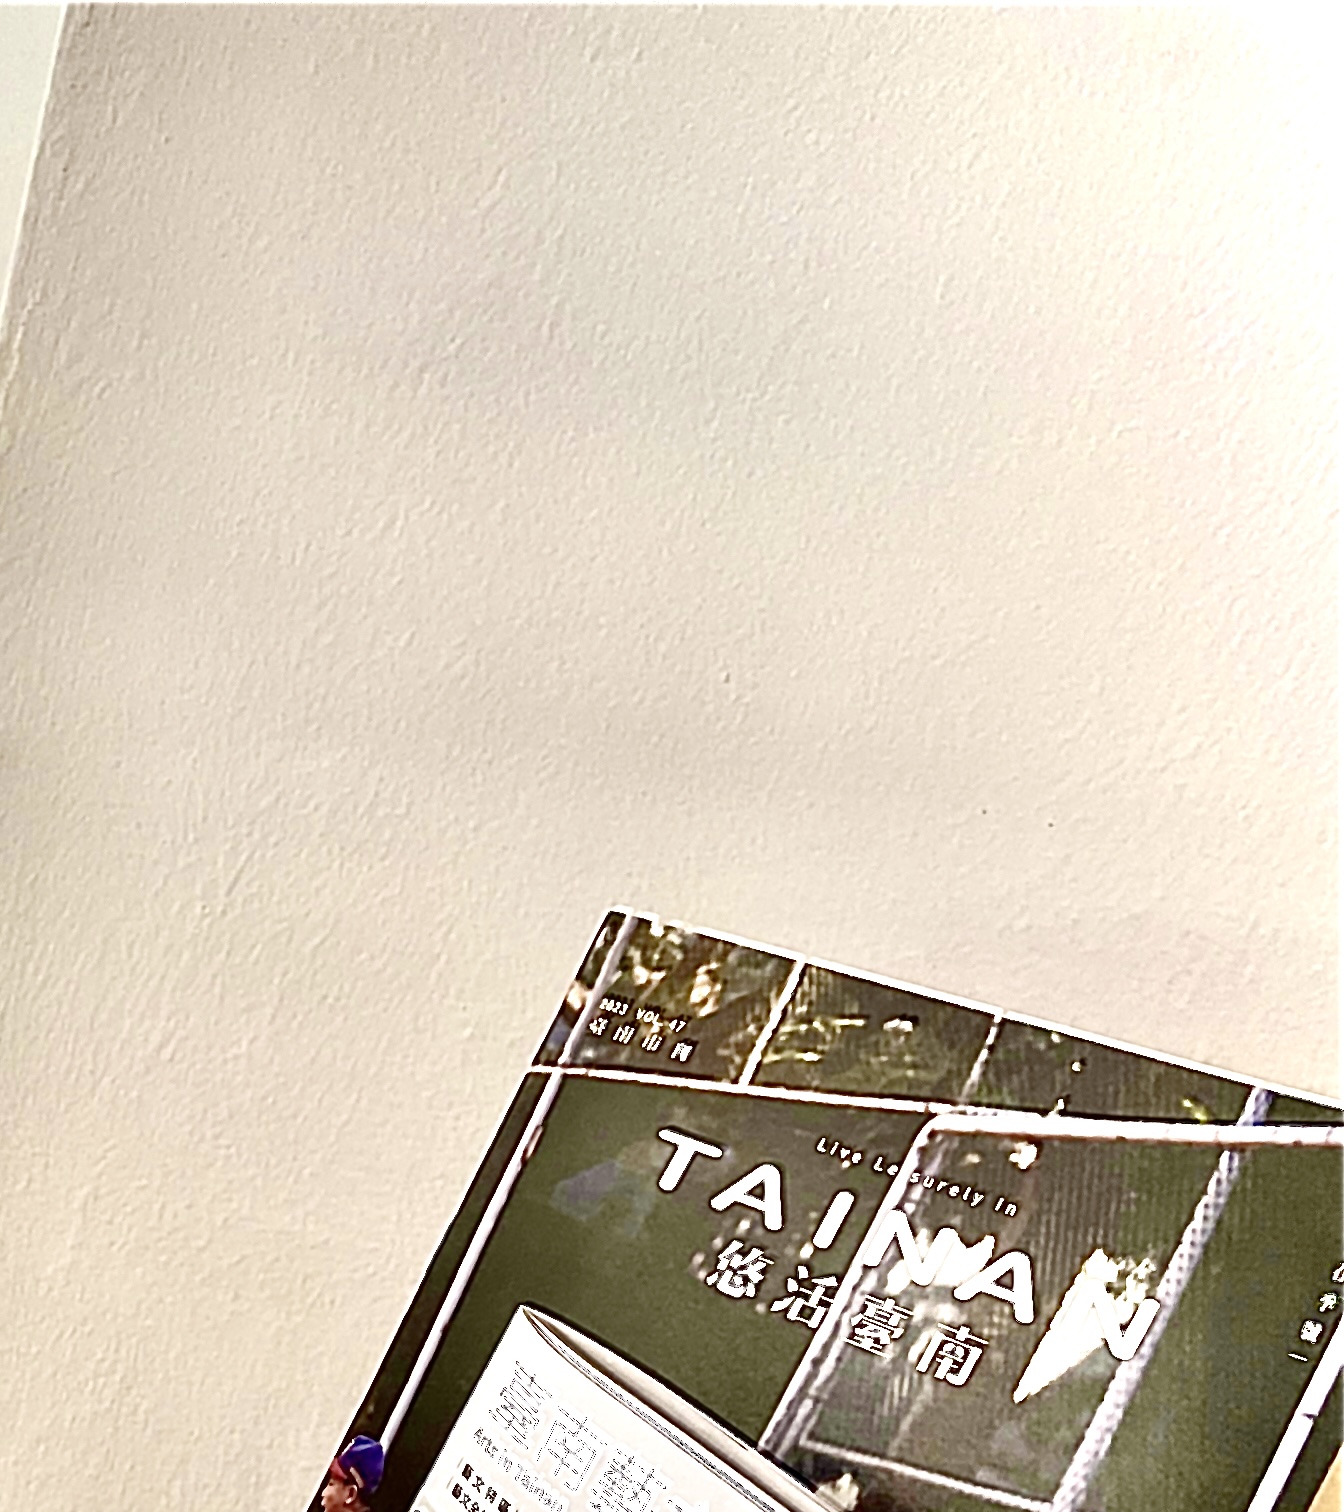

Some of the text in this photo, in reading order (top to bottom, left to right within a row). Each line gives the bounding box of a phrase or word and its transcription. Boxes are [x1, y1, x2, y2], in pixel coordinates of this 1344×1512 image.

[657, 1124, 1162, 1362] TAINAN
[816, 1137, 864, 1165] Live
[873, 1156, 986, 1208] Lesurely
[705, 1238, 990, 1388] 悠活臺南
